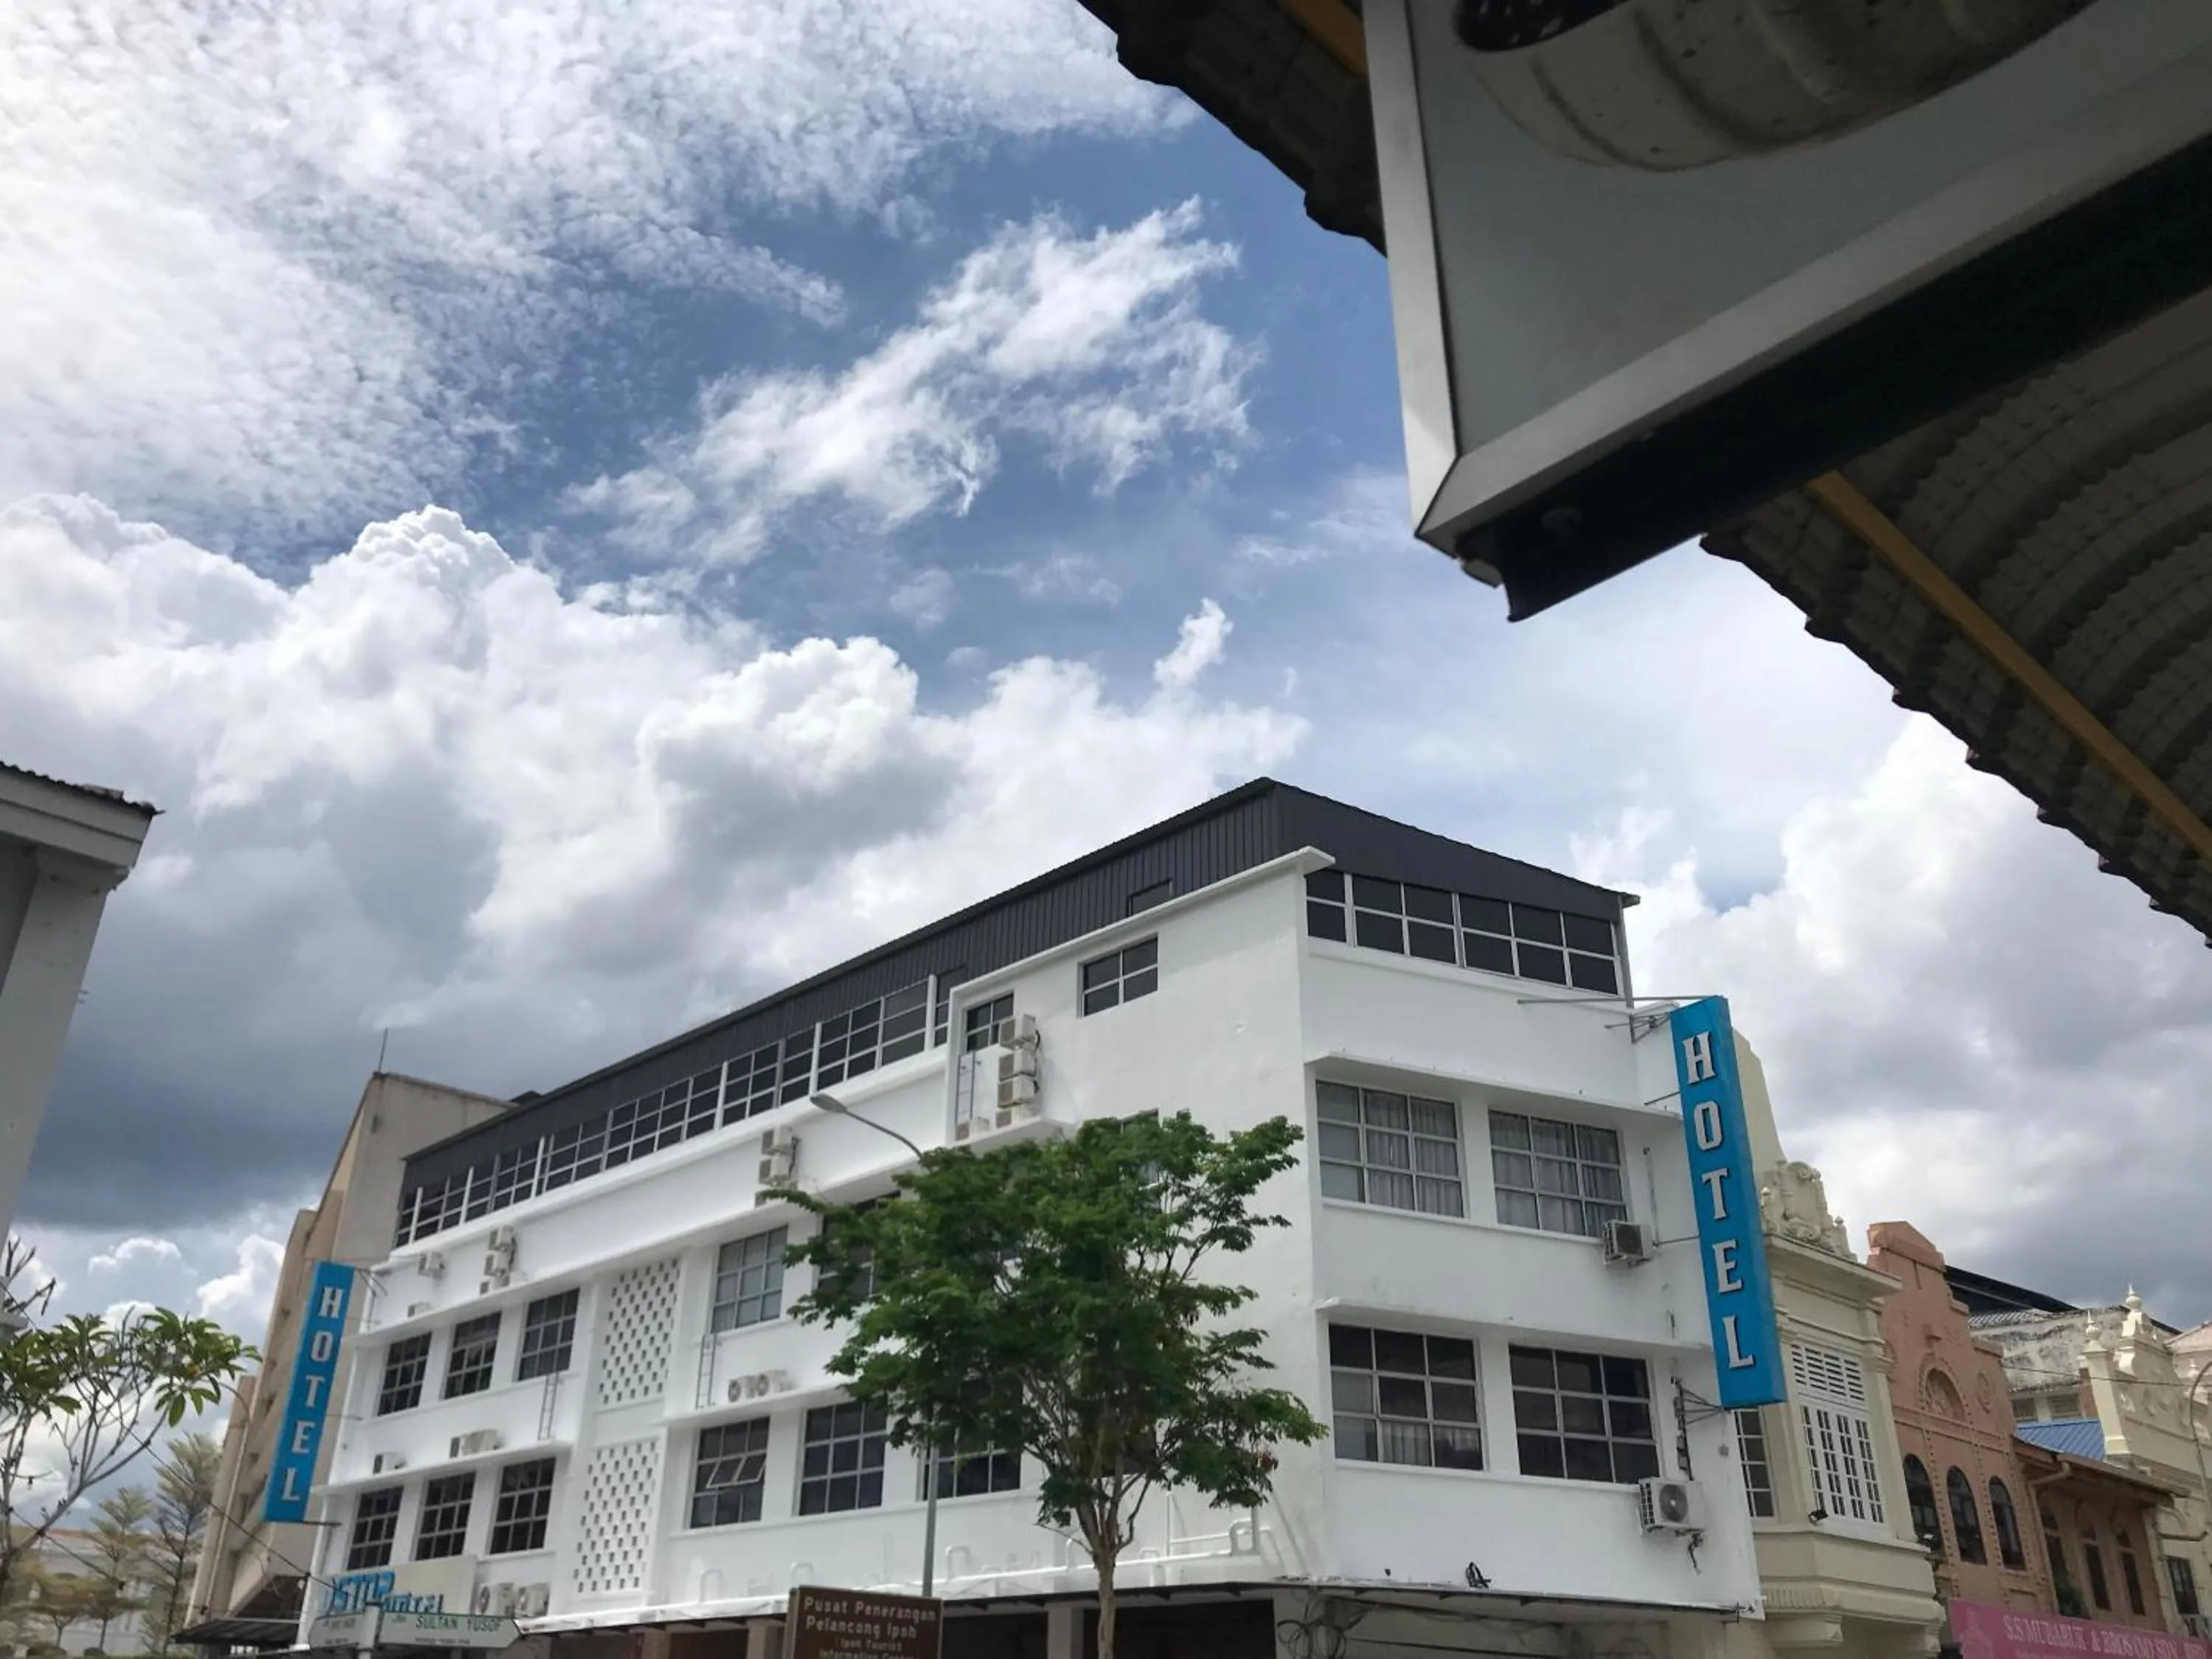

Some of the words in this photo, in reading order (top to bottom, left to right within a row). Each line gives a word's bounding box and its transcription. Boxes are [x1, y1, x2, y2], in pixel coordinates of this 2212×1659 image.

[1682, 1032, 1756, 1370] HOTEL
[281, 1285, 345, 1502] HOTEL
[415, 1615, 457, 1630] SULTAN
[804, 1596, 848, 1614] Pusat
[855, 1601, 936, 1624] Penerangan
[806, 1615, 881, 1639] Pelancong
[887, 1623, 917, 1639] Ipoh
